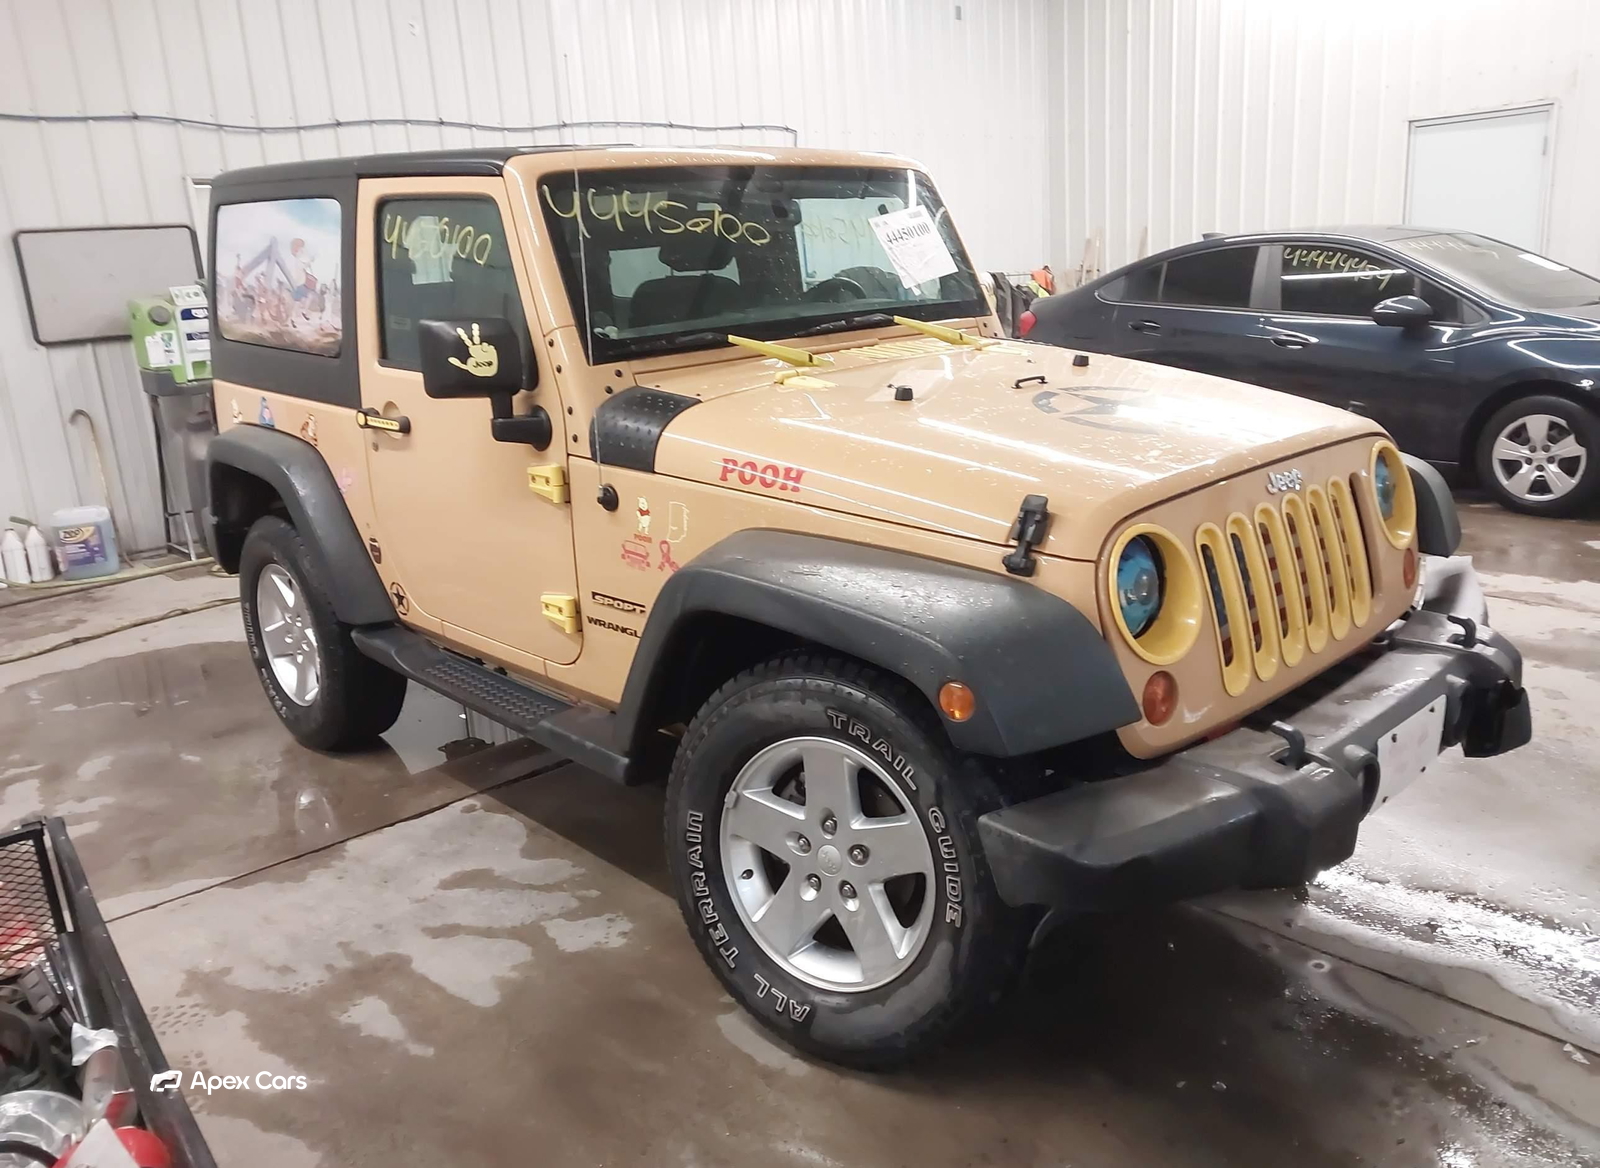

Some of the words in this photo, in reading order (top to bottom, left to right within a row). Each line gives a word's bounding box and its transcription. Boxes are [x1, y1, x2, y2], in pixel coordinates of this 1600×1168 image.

[885, 221, 931, 245] 44450100
[719, 458, 805, 492] POOH
[1265, 469, 1302, 494] Jeep
[592, 594, 646, 613] SPORT
[586, 615, 642, 639] WRANGL
[827, 709, 917, 791] TRAIL
[928, 806, 963, 928] GUIDE
[686, 810, 740, 969] TERRAIN
[753, 972, 811, 1023] ALL
